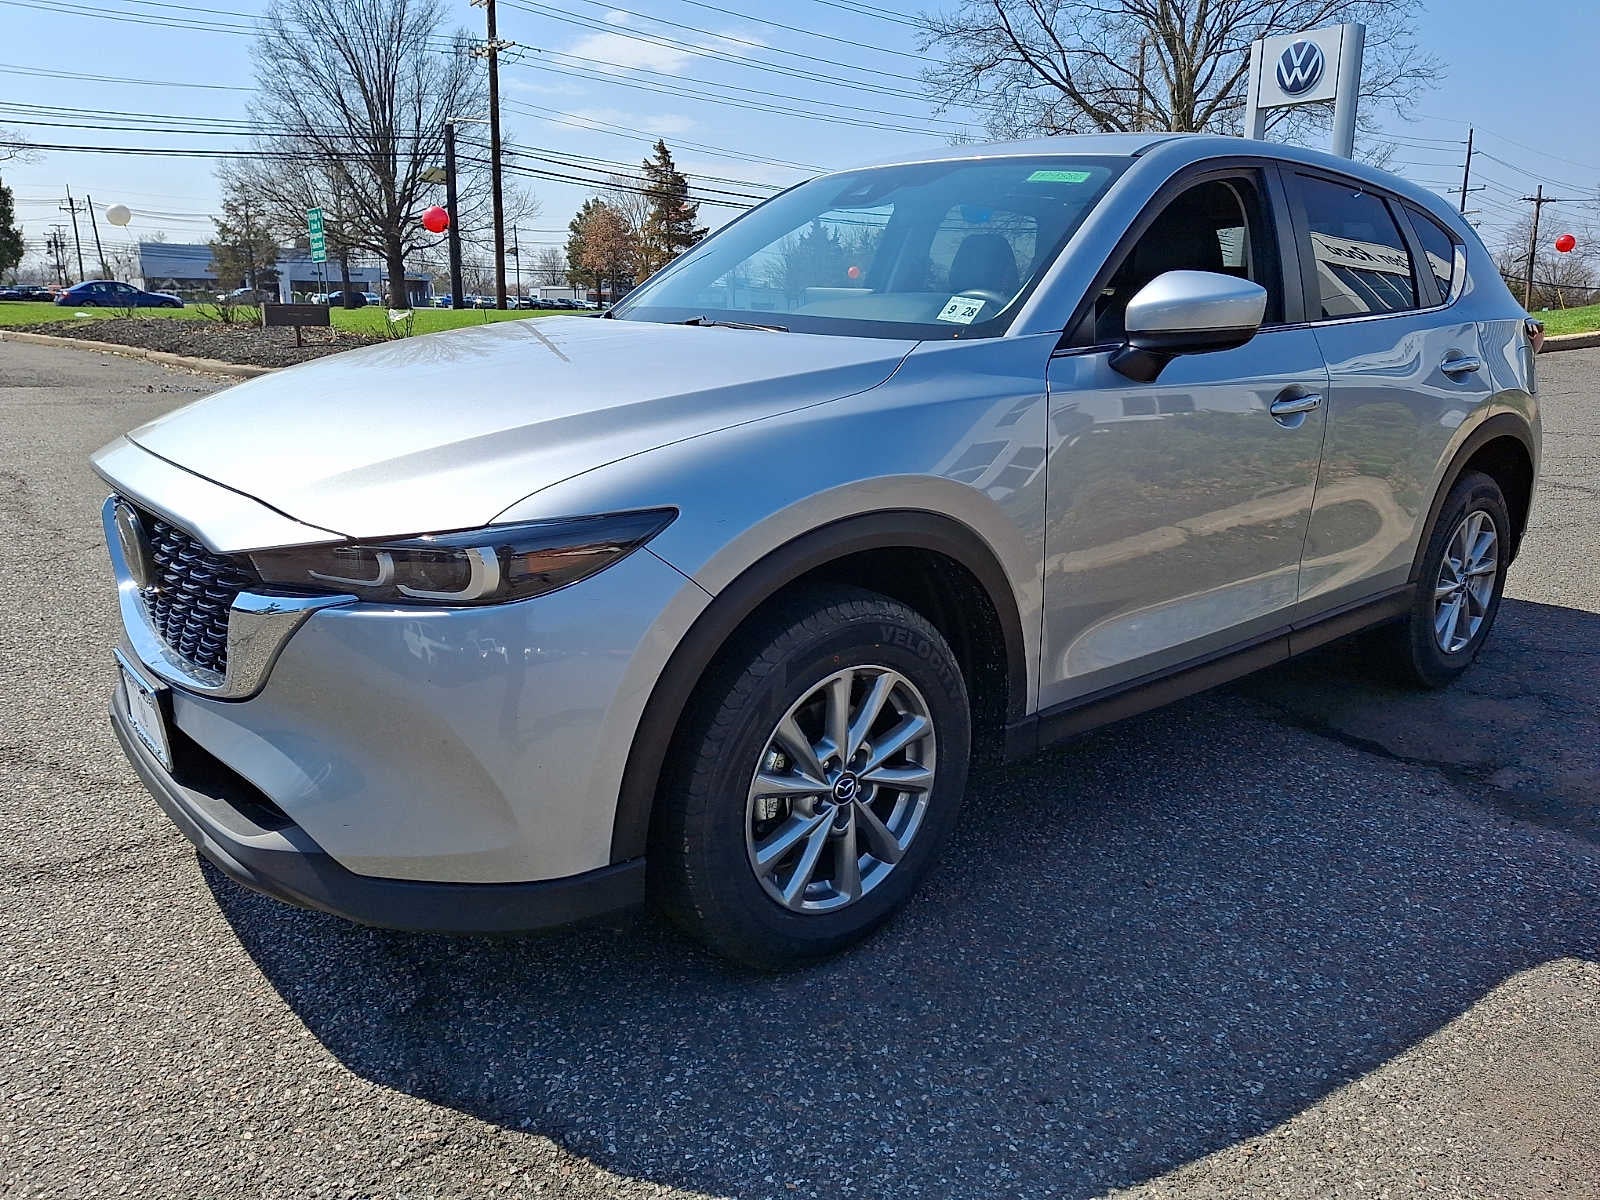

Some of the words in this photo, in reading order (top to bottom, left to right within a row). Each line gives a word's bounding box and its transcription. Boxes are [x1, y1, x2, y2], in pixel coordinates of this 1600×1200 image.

[1277, 40, 1322, 92] VW
[947, 304, 957, 314] 9
[960, 306, 977, 317] 28
